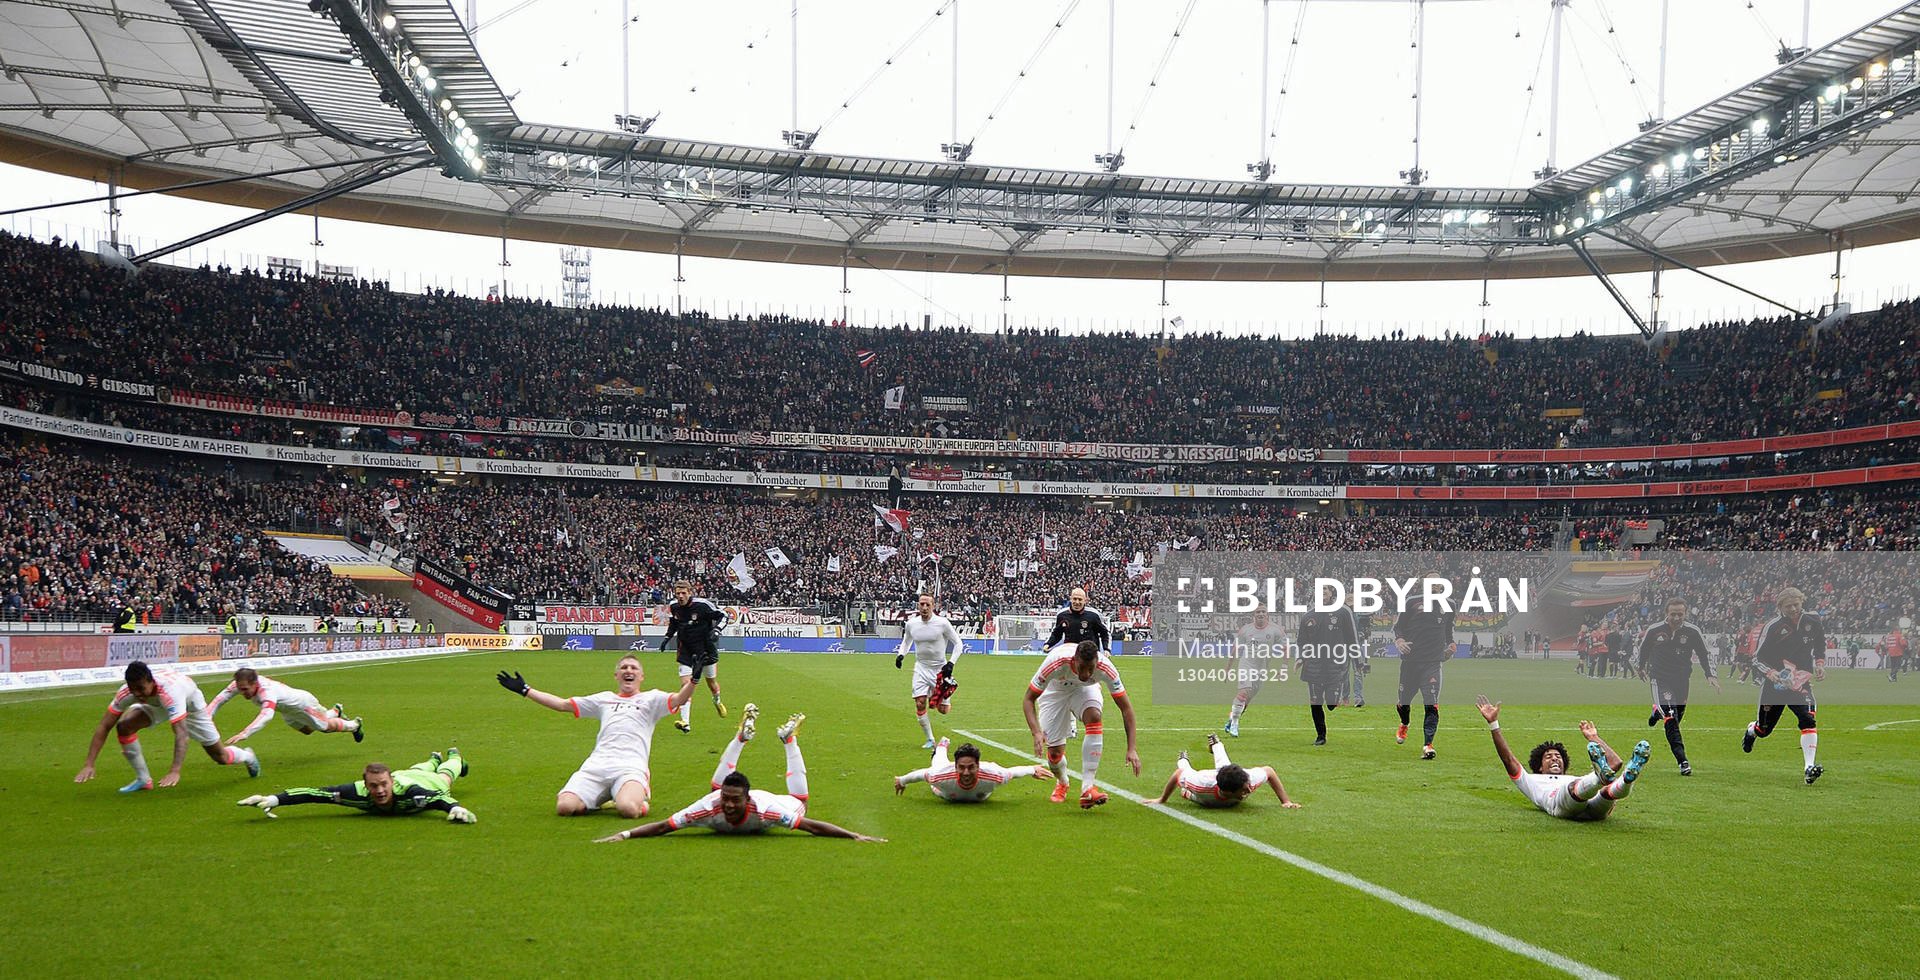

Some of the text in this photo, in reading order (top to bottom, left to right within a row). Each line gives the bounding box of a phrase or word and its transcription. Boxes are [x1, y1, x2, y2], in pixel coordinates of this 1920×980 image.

[22, 362, 155, 396] COMMANDO GIESSEN
[3, 410, 33, 426] Partner
[508, 419, 568, 433] RAGAZZI
[136, 434, 180, 448] FREUDE
[182, 440, 200, 450] AM
[672, 427, 739, 444] Binding
[772, 433, 796, 444] TORE
[841, 437, 849, 446] &
[850, 436, 897, 448] GEWINNEN
[899, 438, 923, 449] WIRD
[925, 439, 941, 449] UNS
[964, 441, 995, 451] EUROPA
[277, 448, 336, 463] Krombacher
[1099, 445, 1160, 459] BRIGADE
[362, 454, 421, 468] Krombacher
[486, 461, 542, 475] Krombacher
[566, 465, 621, 478] Krombacher
[681, 470, 733, 483] Krombacher
[755, 473, 807, 486] Krombacher
[864, 478, 914, 489] Kromher
[936, 480, 985, 492] Krombacher
[1041, 483, 1090, 494] Krombacher
[1216, 487, 1265, 497] Krombacher
[420, 562, 498, 608] EINTRACHT FAN-CLUB
[485, 615, 494, 623] 75
[545, 606, 646, 623] FRANKFURT
[748, 611, 815, 625] Waldstadion
[536, 623, 598, 635] Krombacher
[744, 626, 802, 637] Krombacher
[1826, 652, 1867, 667] mbacer
